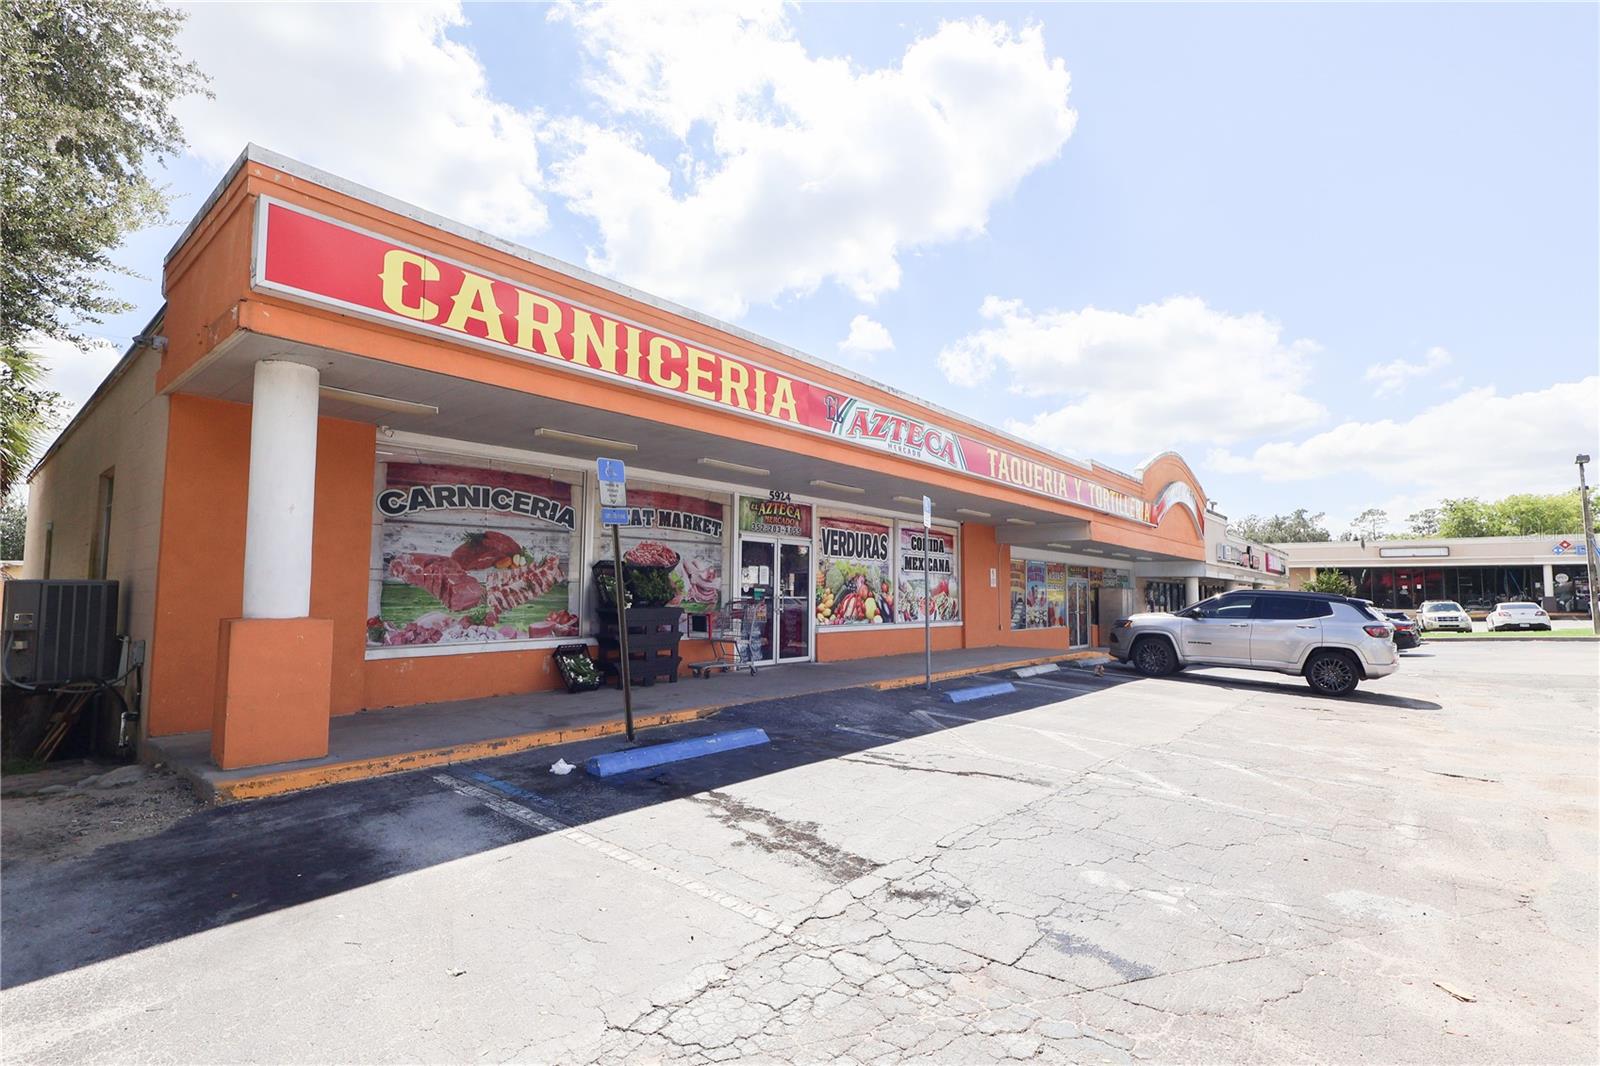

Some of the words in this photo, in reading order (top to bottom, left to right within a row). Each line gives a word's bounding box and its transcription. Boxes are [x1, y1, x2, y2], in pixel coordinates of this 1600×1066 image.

[377, 249, 801, 424] CARNICERIA
[847, 408, 957, 464] AZTECA
[887, 443, 921, 458] MERCADO
[769, 490, 792, 503] 5924
[986, 448, 1069, 499] TAQUERIA
[1074, 477, 1083, 502] Y
[1087, 483, 1151, 522] TORTILLERIA
[377, 485, 575, 530] CARNICERIA
[657, 510, 723, 536] MARKET
[759, 502, 801, 521] AZTECA
[821, 528, 888, 560] VERDURAS
